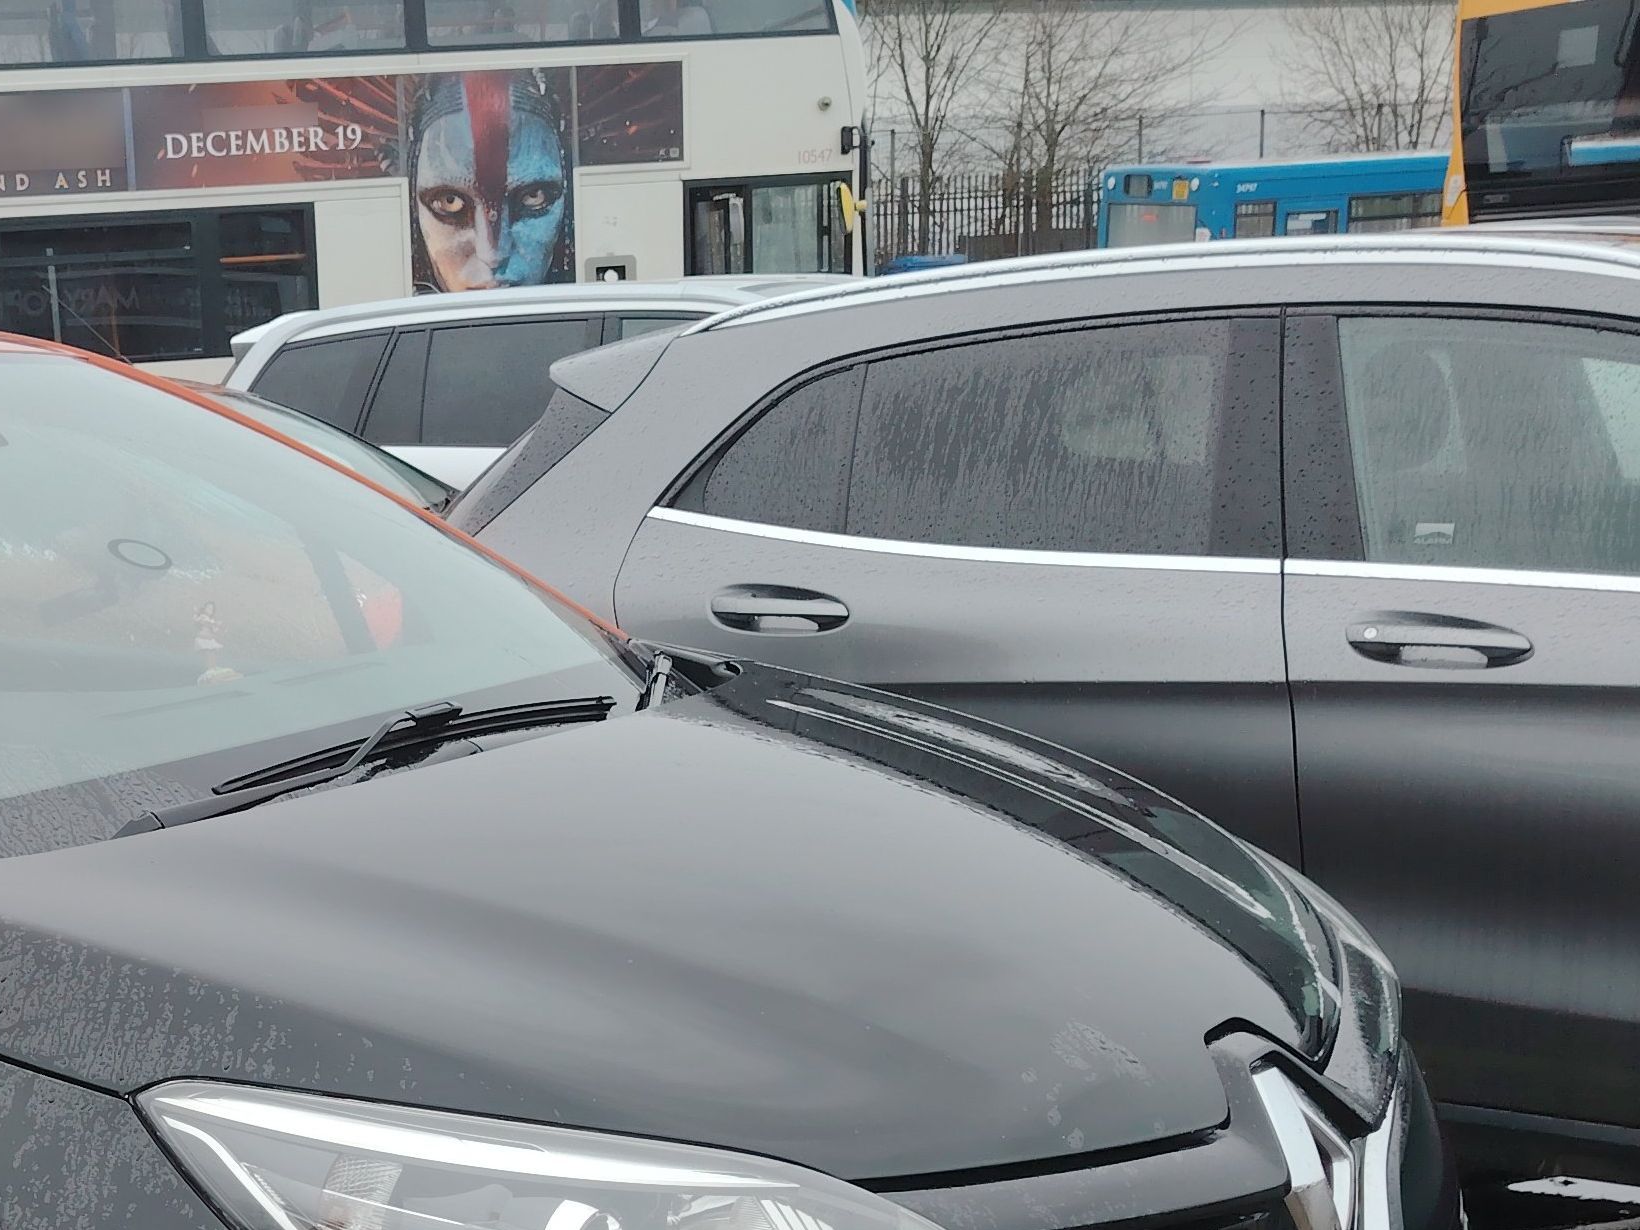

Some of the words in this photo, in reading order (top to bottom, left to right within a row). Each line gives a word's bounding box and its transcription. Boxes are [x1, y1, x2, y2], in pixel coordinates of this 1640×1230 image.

[164, 125, 329, 159] DECEMBER
[335, 122, 362, 150] 19
[54, 168, 112, 190] ASH
